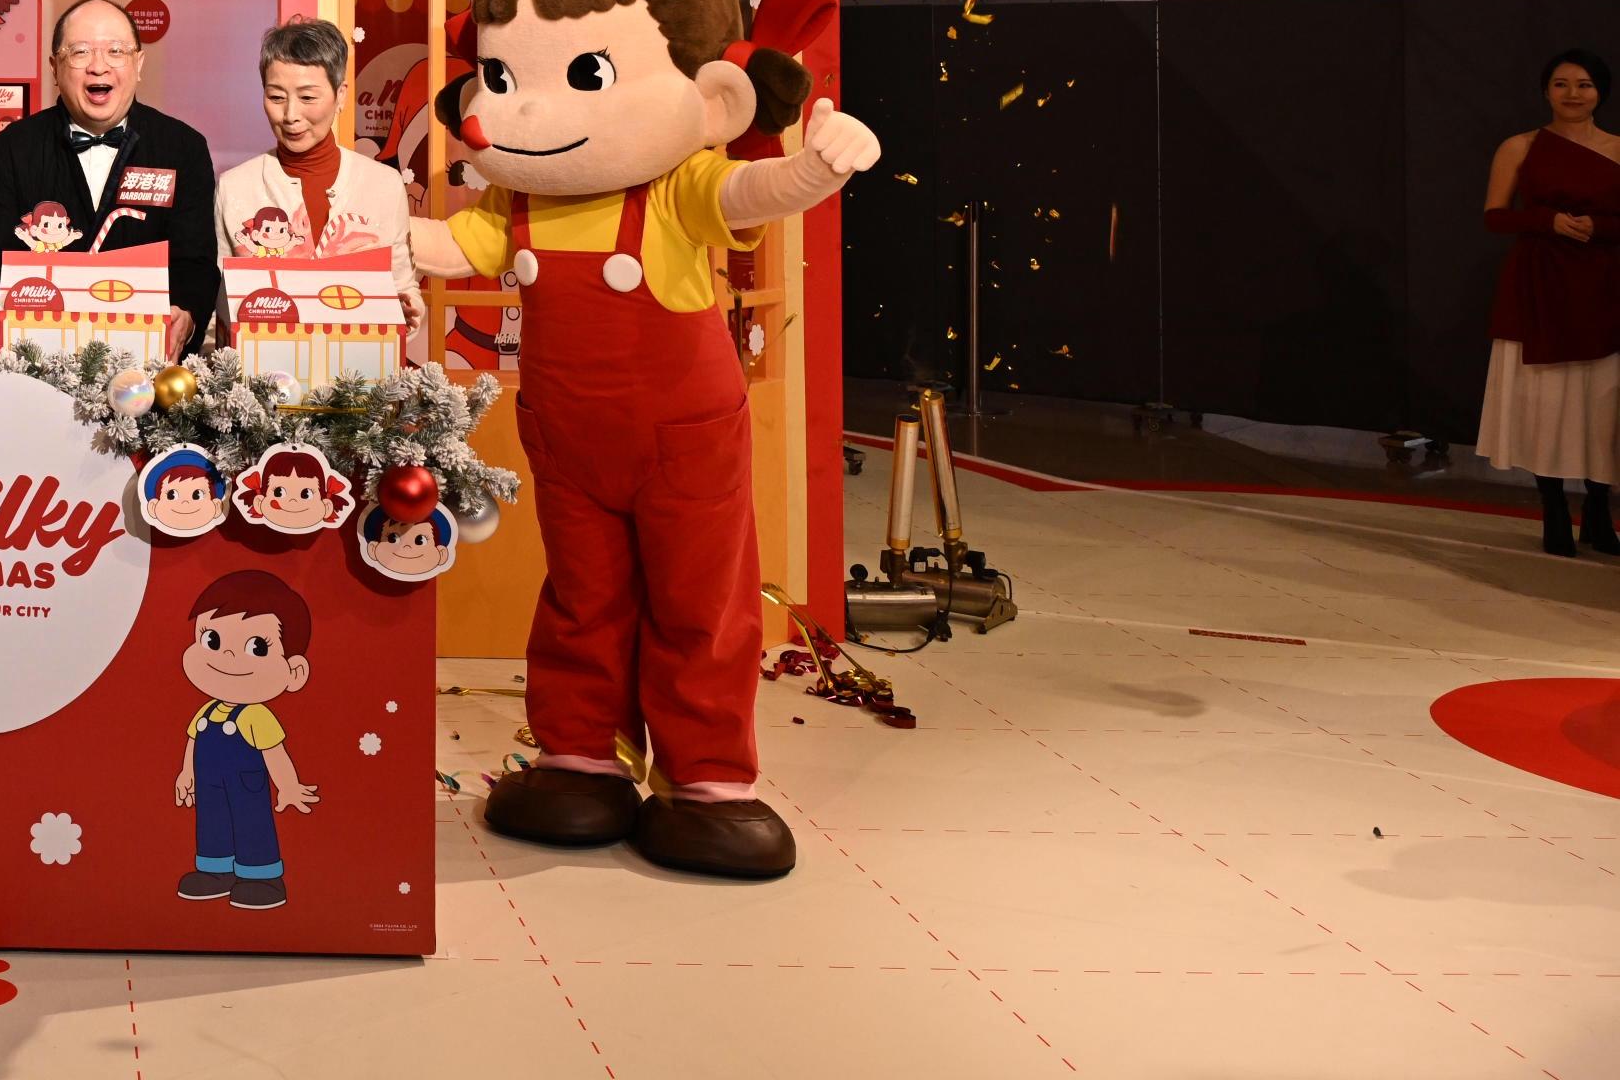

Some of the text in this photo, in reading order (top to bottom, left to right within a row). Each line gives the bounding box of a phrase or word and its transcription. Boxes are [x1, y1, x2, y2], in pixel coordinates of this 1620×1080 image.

[121, 172, 172, 191] 海港城
[119, 191, 171, 202] HARBOUR CITY
[19, 285, 57, 301] Milky
[253, 296, 292, 312] Milky
[16, 605, 51, 618] CITY
